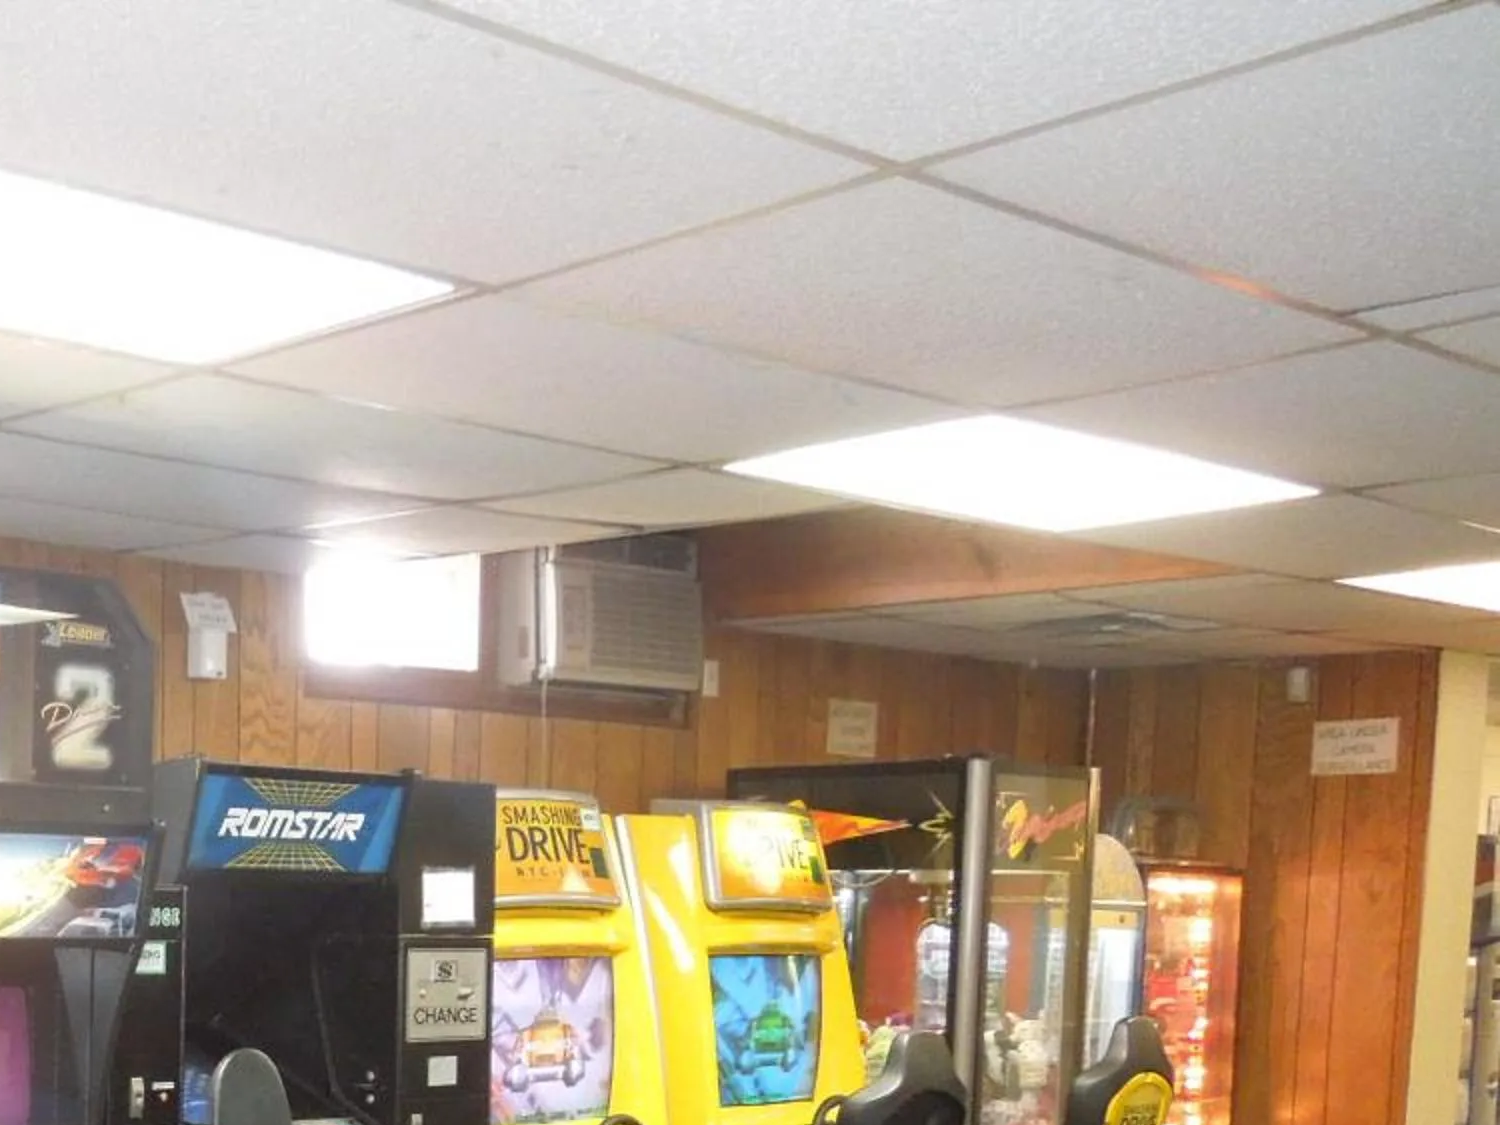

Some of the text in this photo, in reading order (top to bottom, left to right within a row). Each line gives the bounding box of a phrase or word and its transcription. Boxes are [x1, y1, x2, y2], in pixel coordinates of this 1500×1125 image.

[217, 806, 366, 842] ROMSTAR
[506, 826, 590, 865] DRIVE
[413, 1007, 477, 1026] CHANGE
